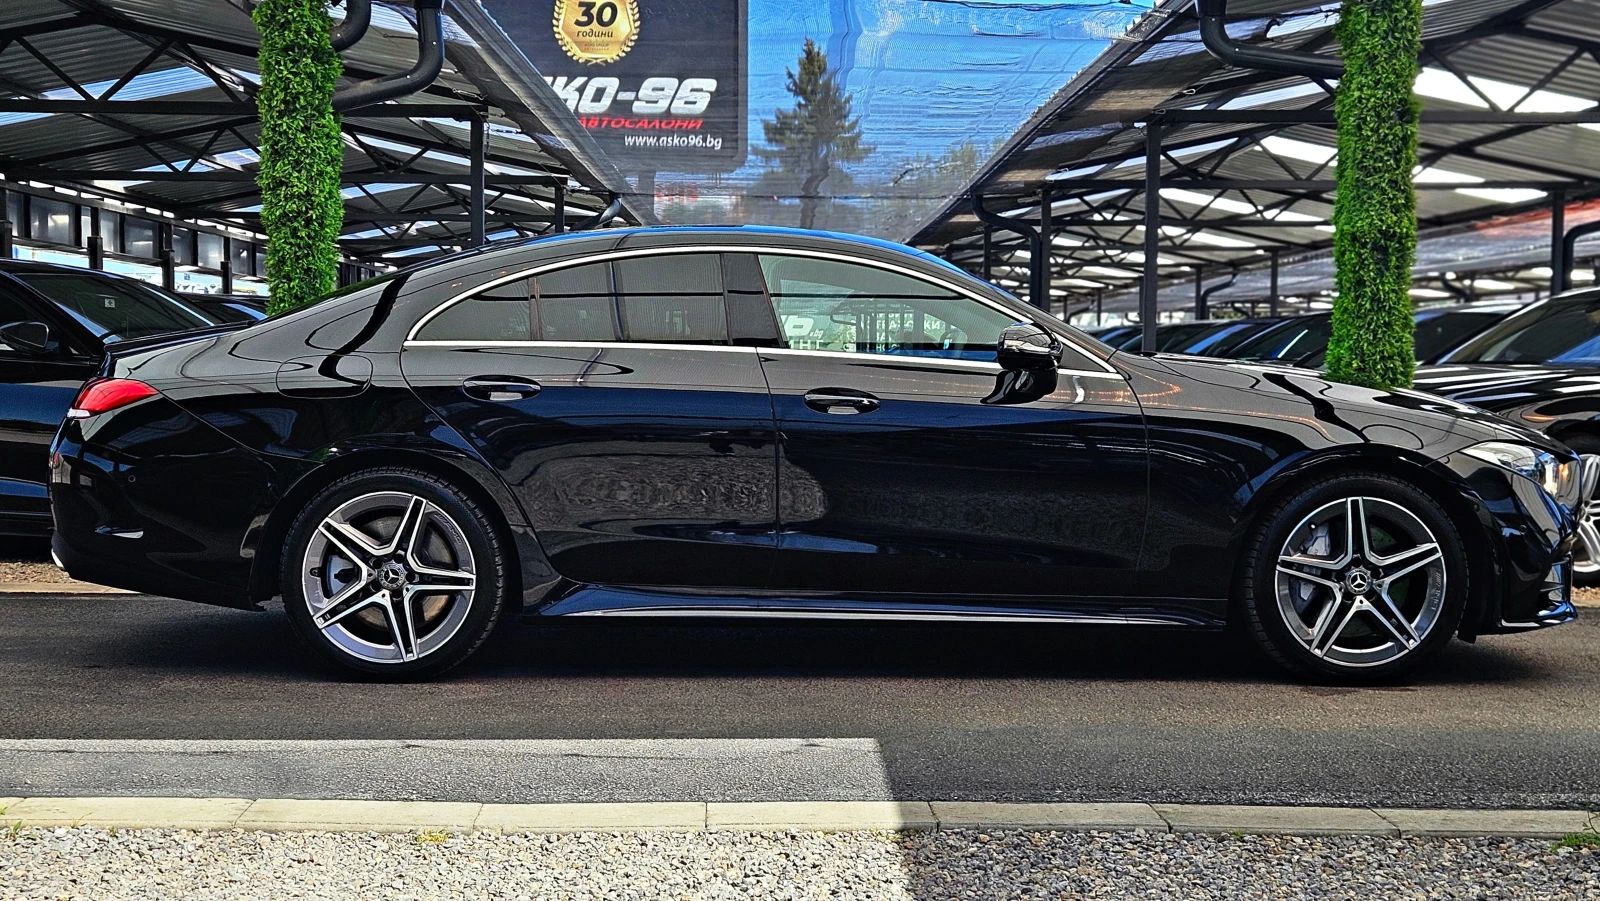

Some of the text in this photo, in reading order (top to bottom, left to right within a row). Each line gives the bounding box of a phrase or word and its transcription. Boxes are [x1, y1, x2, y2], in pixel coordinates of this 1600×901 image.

[574, 1, 618, 27] 30
[576, 29, 613, 38] години
[543, 76, 717, 114] KO-96
[624, 133, 722, 150] www.asko96.bg
